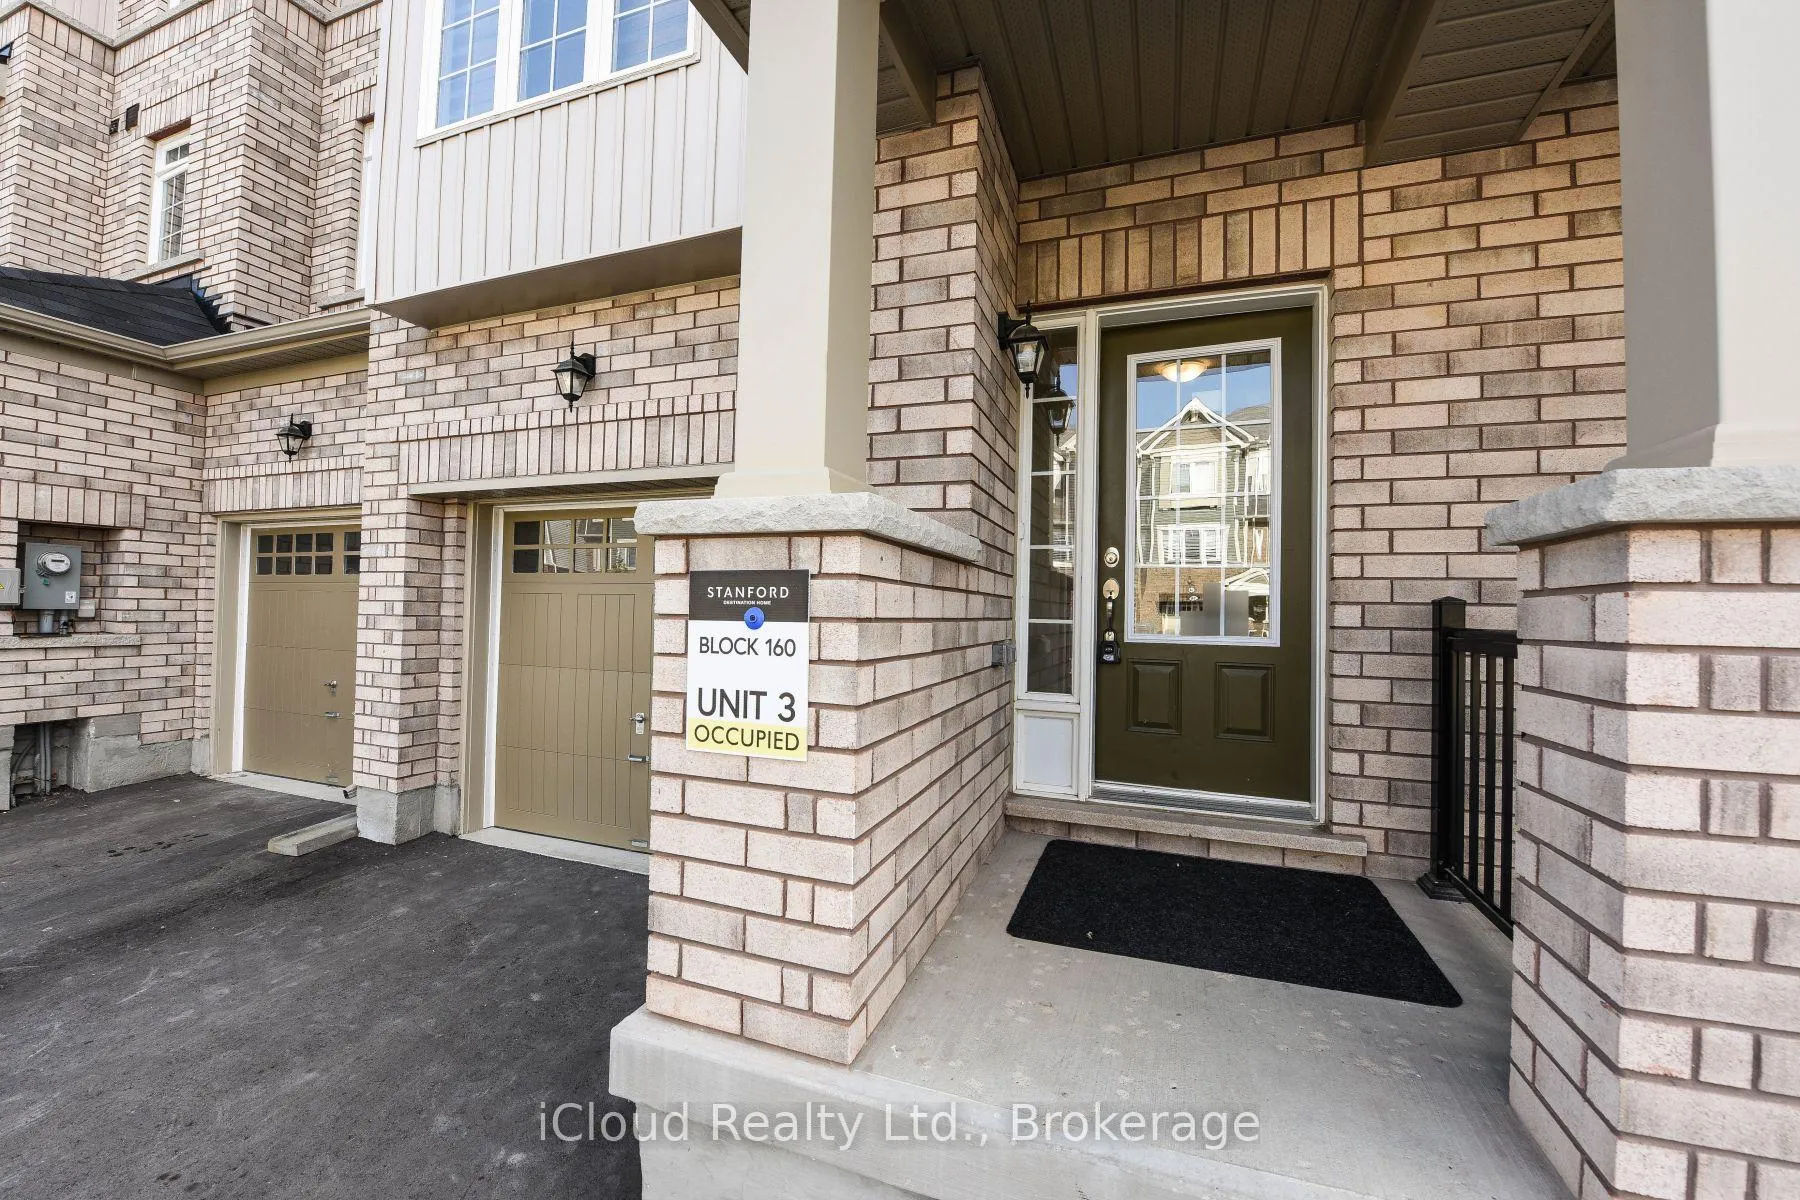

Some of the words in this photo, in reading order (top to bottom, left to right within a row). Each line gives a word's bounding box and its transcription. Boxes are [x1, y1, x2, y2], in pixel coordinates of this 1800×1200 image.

[707, 586, 789, 599] STANFORD
[699, 636, 759, 656] BLOCK
[765, 638, 796, 658] 160
[698, 687, 768, 720] UNIT
[777, 692, 796, 723] 3
[694, 724, 800, 751] OCCUPIED
